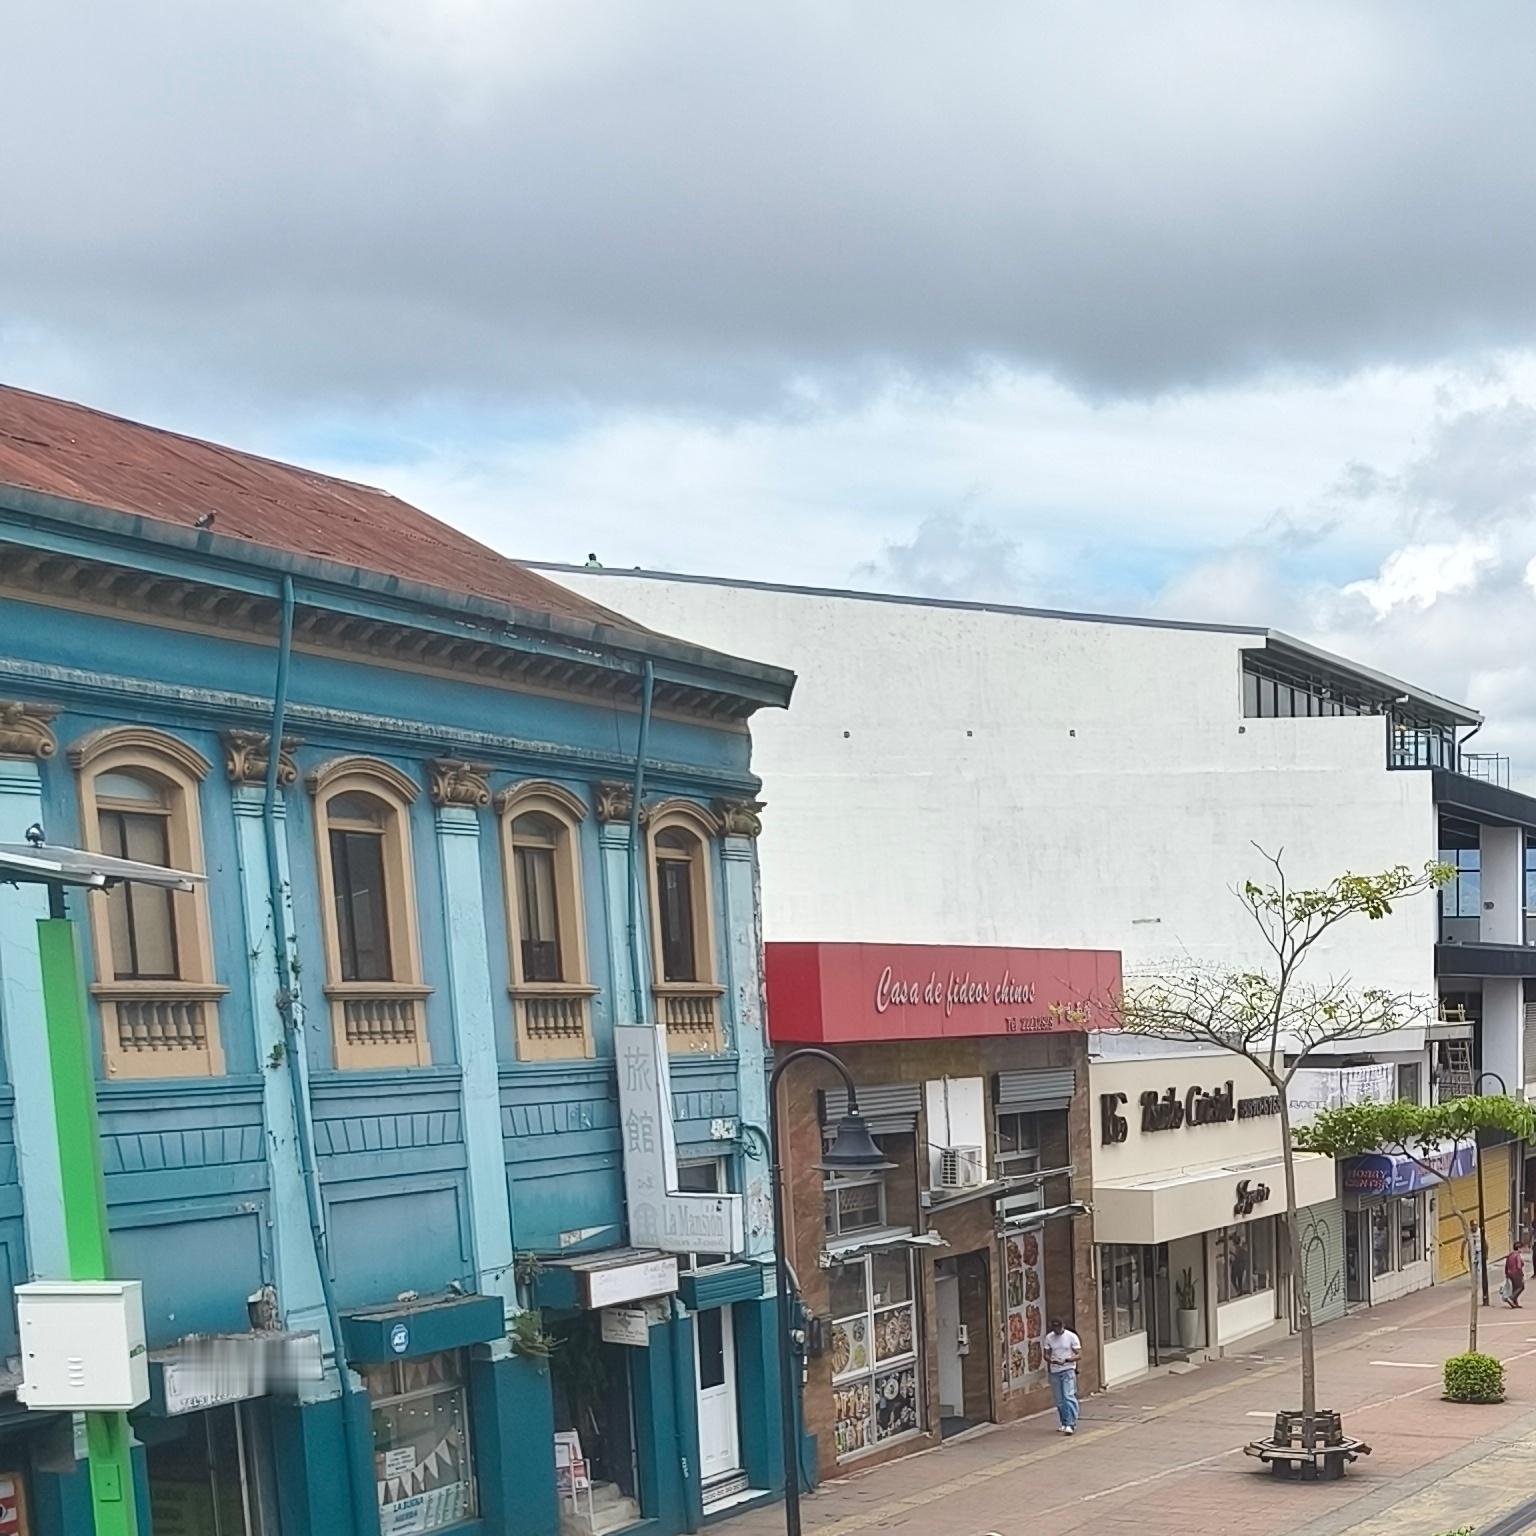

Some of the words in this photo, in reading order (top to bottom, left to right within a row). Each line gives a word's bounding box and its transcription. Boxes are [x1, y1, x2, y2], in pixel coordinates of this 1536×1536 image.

[876, 966, 919, 1014] Casa
[924, 970, 943, 1005] de
[945, 970, 991, 1017] fideos
[994, 970, 1036, 1005] chinos
[663, 1204, 677, 1236] La
